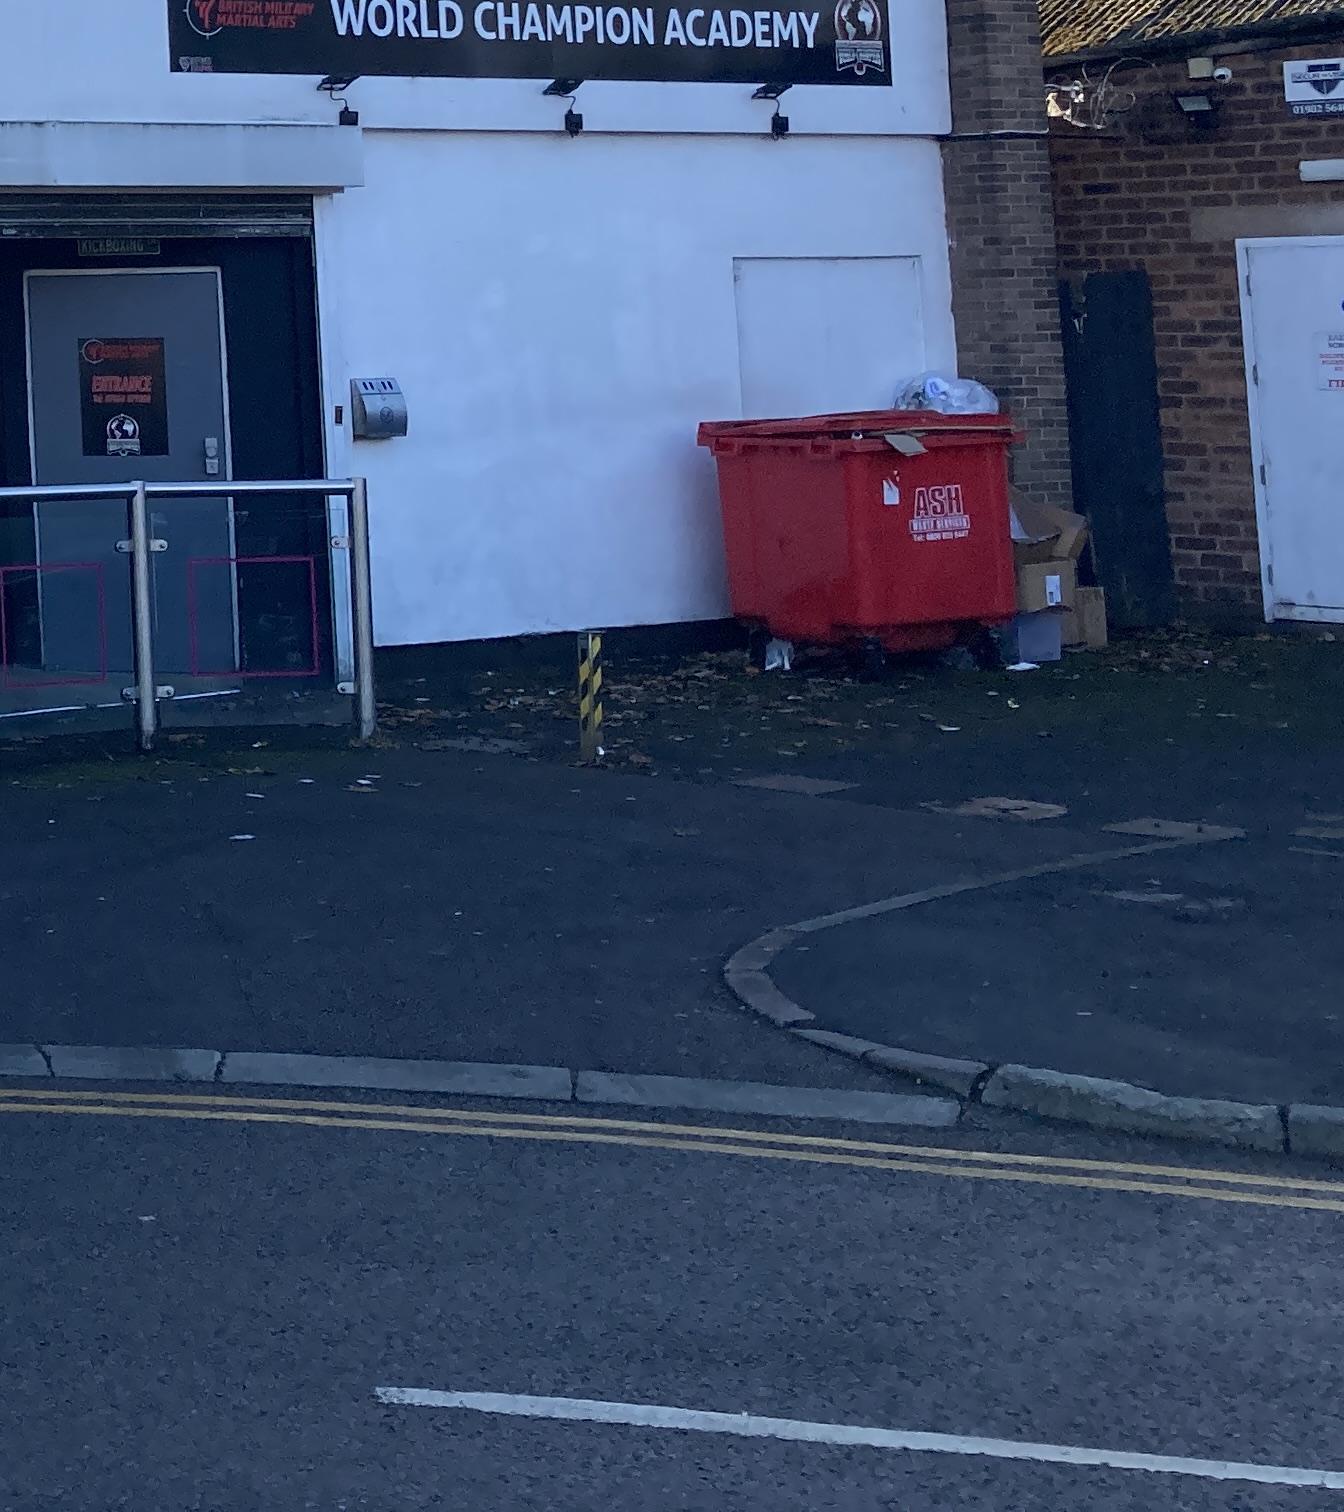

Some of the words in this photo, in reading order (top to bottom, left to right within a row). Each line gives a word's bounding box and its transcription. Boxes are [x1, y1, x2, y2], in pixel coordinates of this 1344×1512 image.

[218, 0, 261, 14] BRITISH
[264, 1, 315, 16] MILITARY
[217, 13, 265, 27] MARTIAL
[269, 15, 296, 28] ARTS
[474, 0, 656, 46] CHAMPION
[664, 7, 821, 49] ACADEMY
[81, 238, 144, 254] KICKBOXING
[914, 485, 963, 518] ASH
